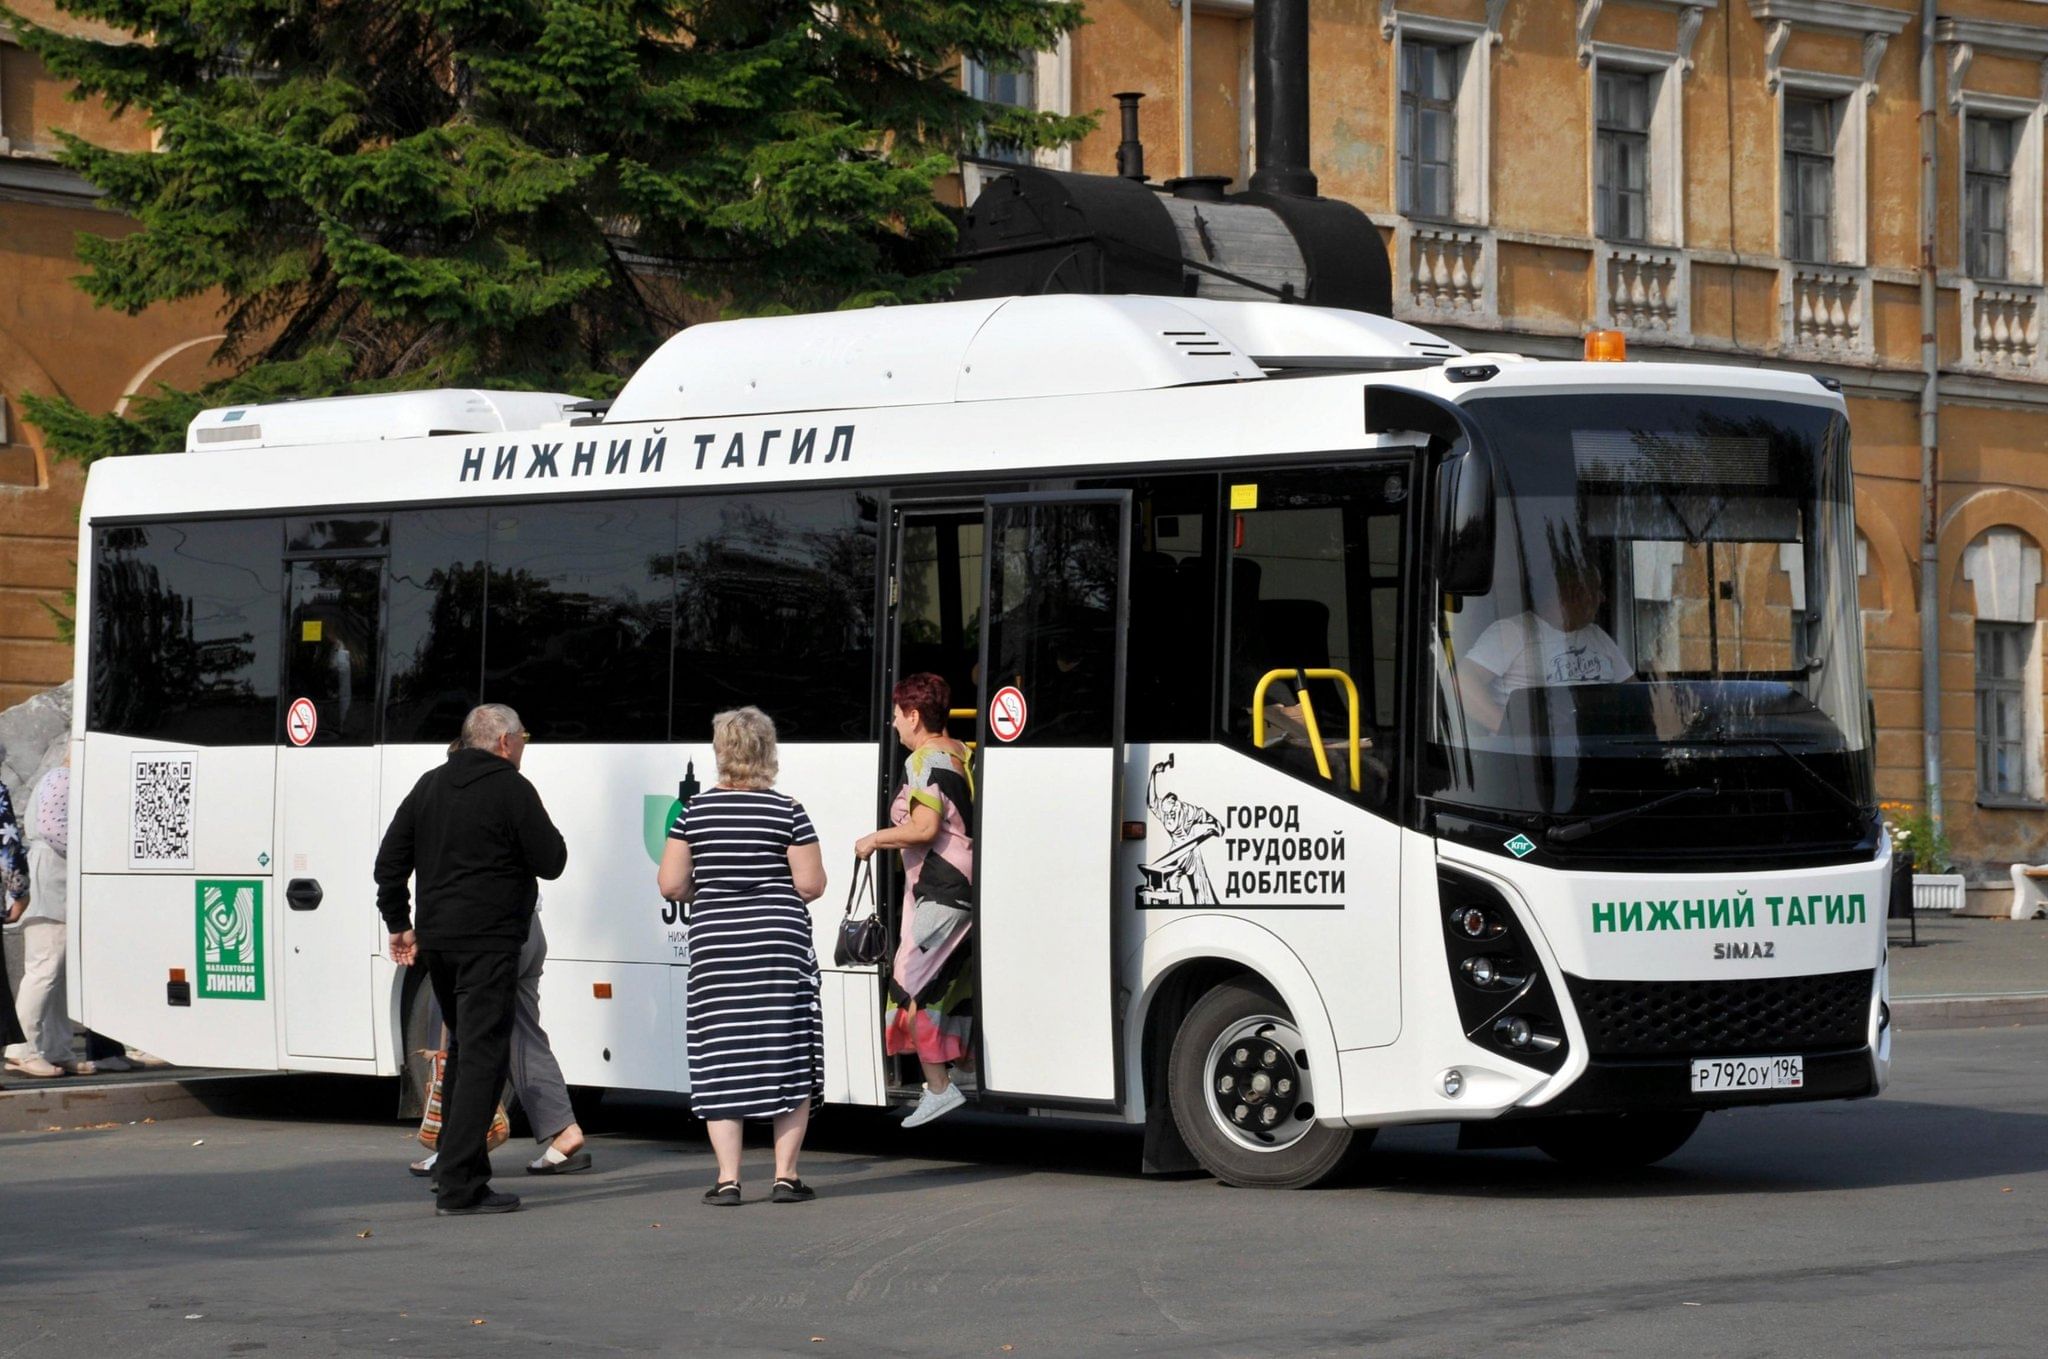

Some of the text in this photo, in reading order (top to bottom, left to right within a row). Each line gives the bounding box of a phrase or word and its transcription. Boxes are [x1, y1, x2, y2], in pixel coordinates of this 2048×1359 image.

[459, 425, 855, 482] НИЖНИЙ ТАГИЛ
[1226, 805, 1300, 832] ГОРОД
[1225, 830, 1345, 865] ТРУДОВОЙ
[1511, 841, 1529, 851] КПГ
[1225, 870, 1345, 898] ДОБЛЕСТИ
[1592, 889, 1866, 933] НИЖНИЙ ТАГИЛ
[1713, 941, 1776, 960] SIMAZ
[206, 975, 255, 993] ЛИНИЯ
